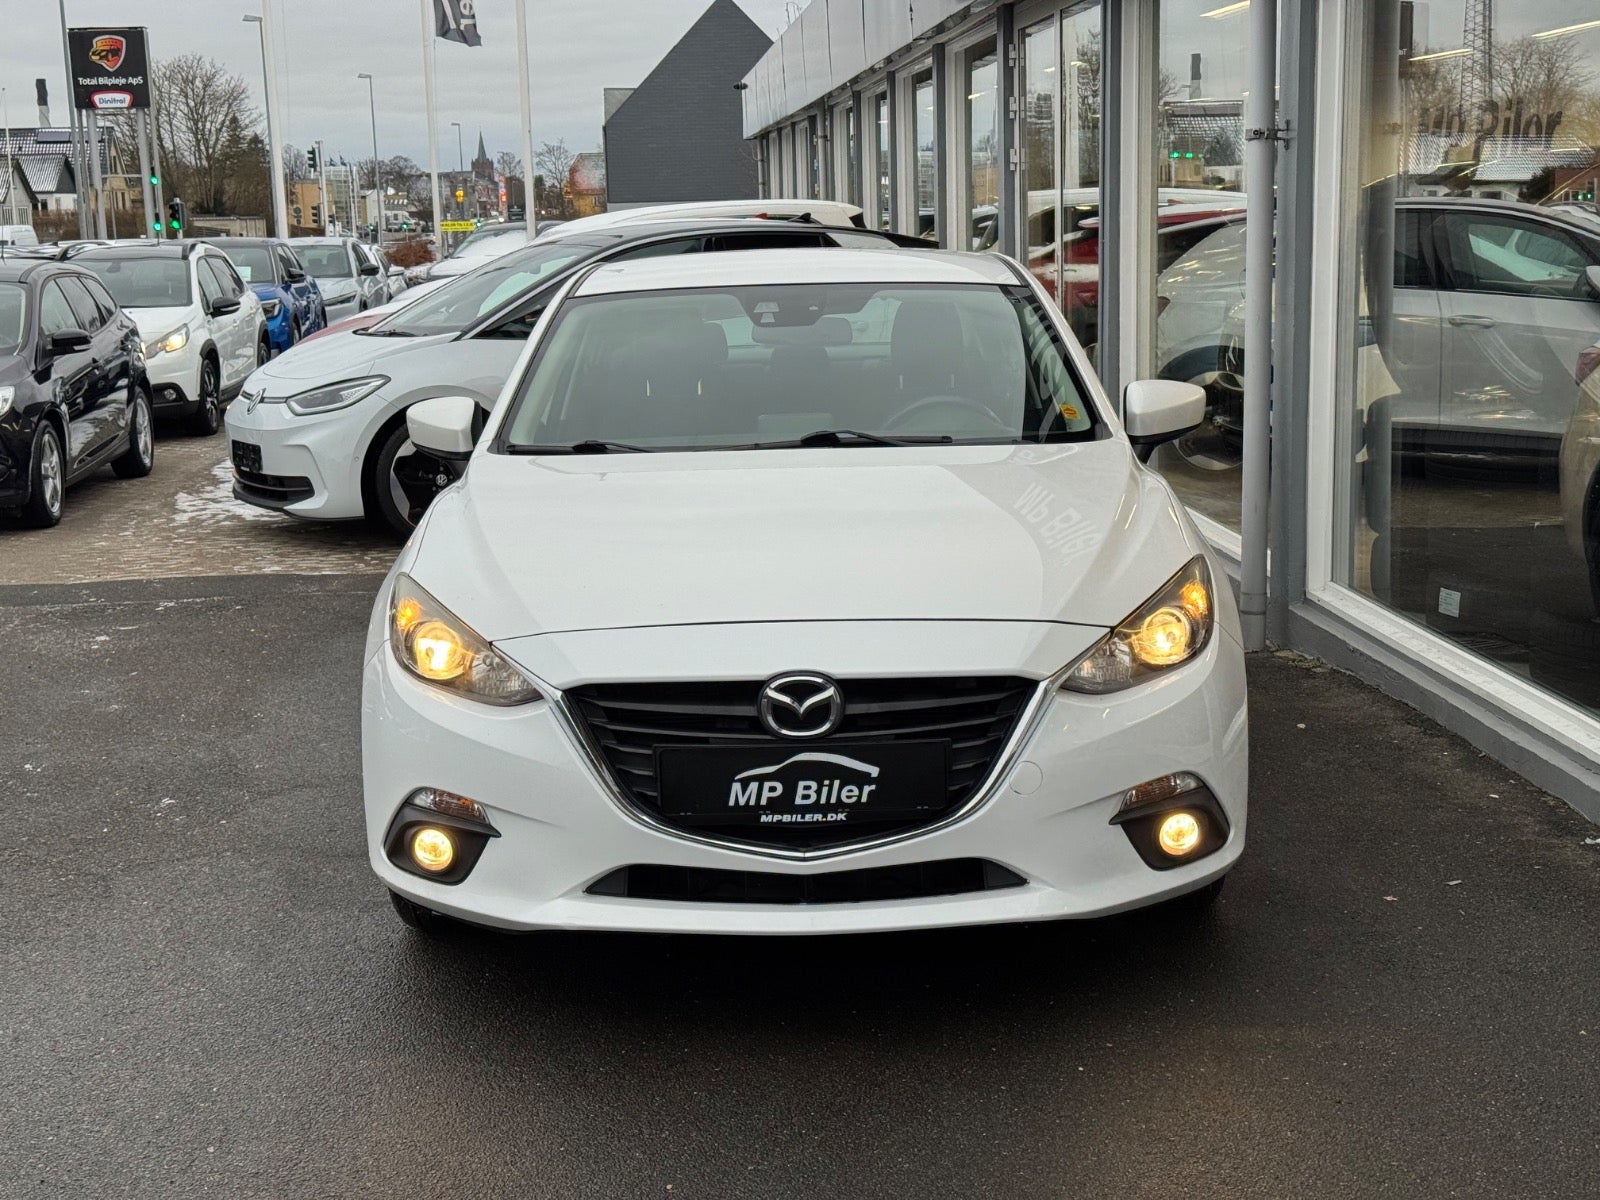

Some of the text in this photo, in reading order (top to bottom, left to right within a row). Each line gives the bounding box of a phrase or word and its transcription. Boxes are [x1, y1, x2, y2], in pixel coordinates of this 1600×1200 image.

[78, 76, 143, 86] Total Bilpleje ApS
[728, 778, 877, 807] MP Biler
[760, 811, 848, 823] MPBILER.DK
